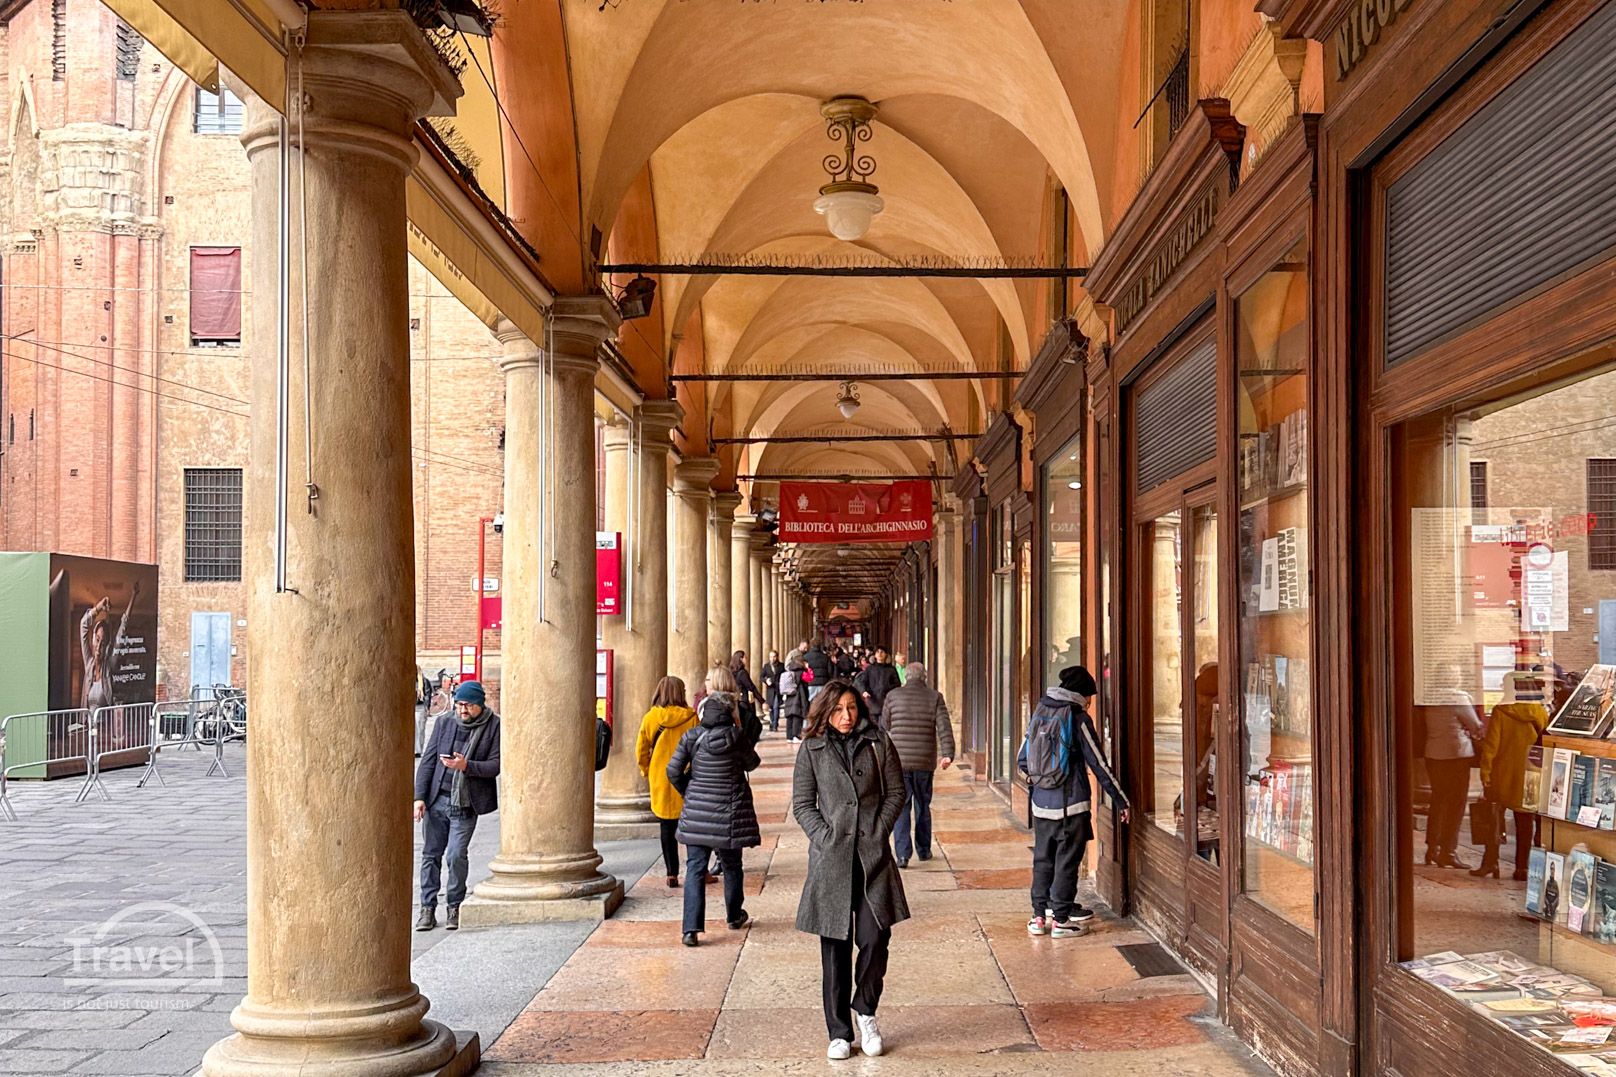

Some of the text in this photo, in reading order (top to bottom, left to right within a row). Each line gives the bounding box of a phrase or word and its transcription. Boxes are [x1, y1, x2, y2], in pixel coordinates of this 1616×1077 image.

[1115, 277, 1145, 334] NICOLA
[785, 519, 927, 534] BIBLIOTECA DELL'ARCHIGINNASIO
[1286, 529, 1299, 609] MAGNUM
